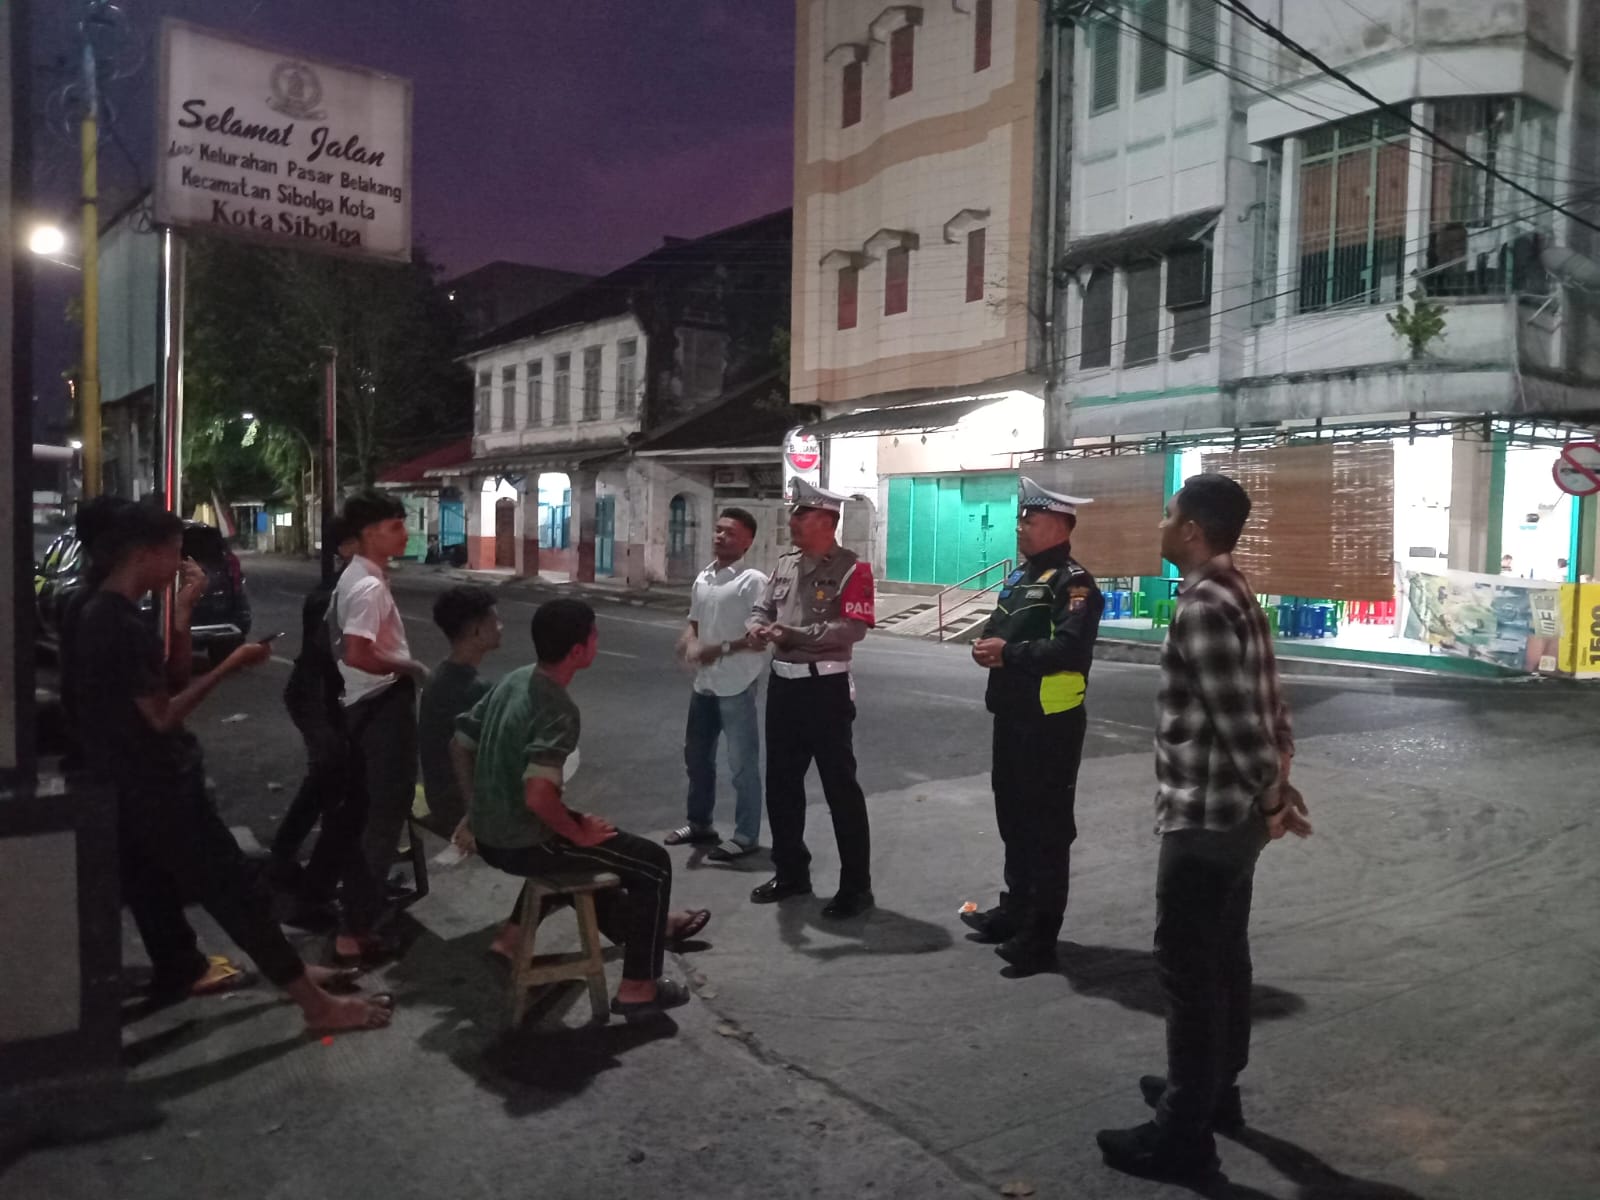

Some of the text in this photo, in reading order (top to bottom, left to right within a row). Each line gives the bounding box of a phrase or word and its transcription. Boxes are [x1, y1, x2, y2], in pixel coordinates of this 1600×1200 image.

[178, 99, 385, 168] Selamat Jalan
[181, 166, 376, 220] Kecamatan Sibolga Kota
[200, 143, 278, 174] Kelurahan
[288, 160, 334, 185] Pasar
[340, 172, 402, 202] Belakang
[211, 200, 362, 247] Kota Sibolga
